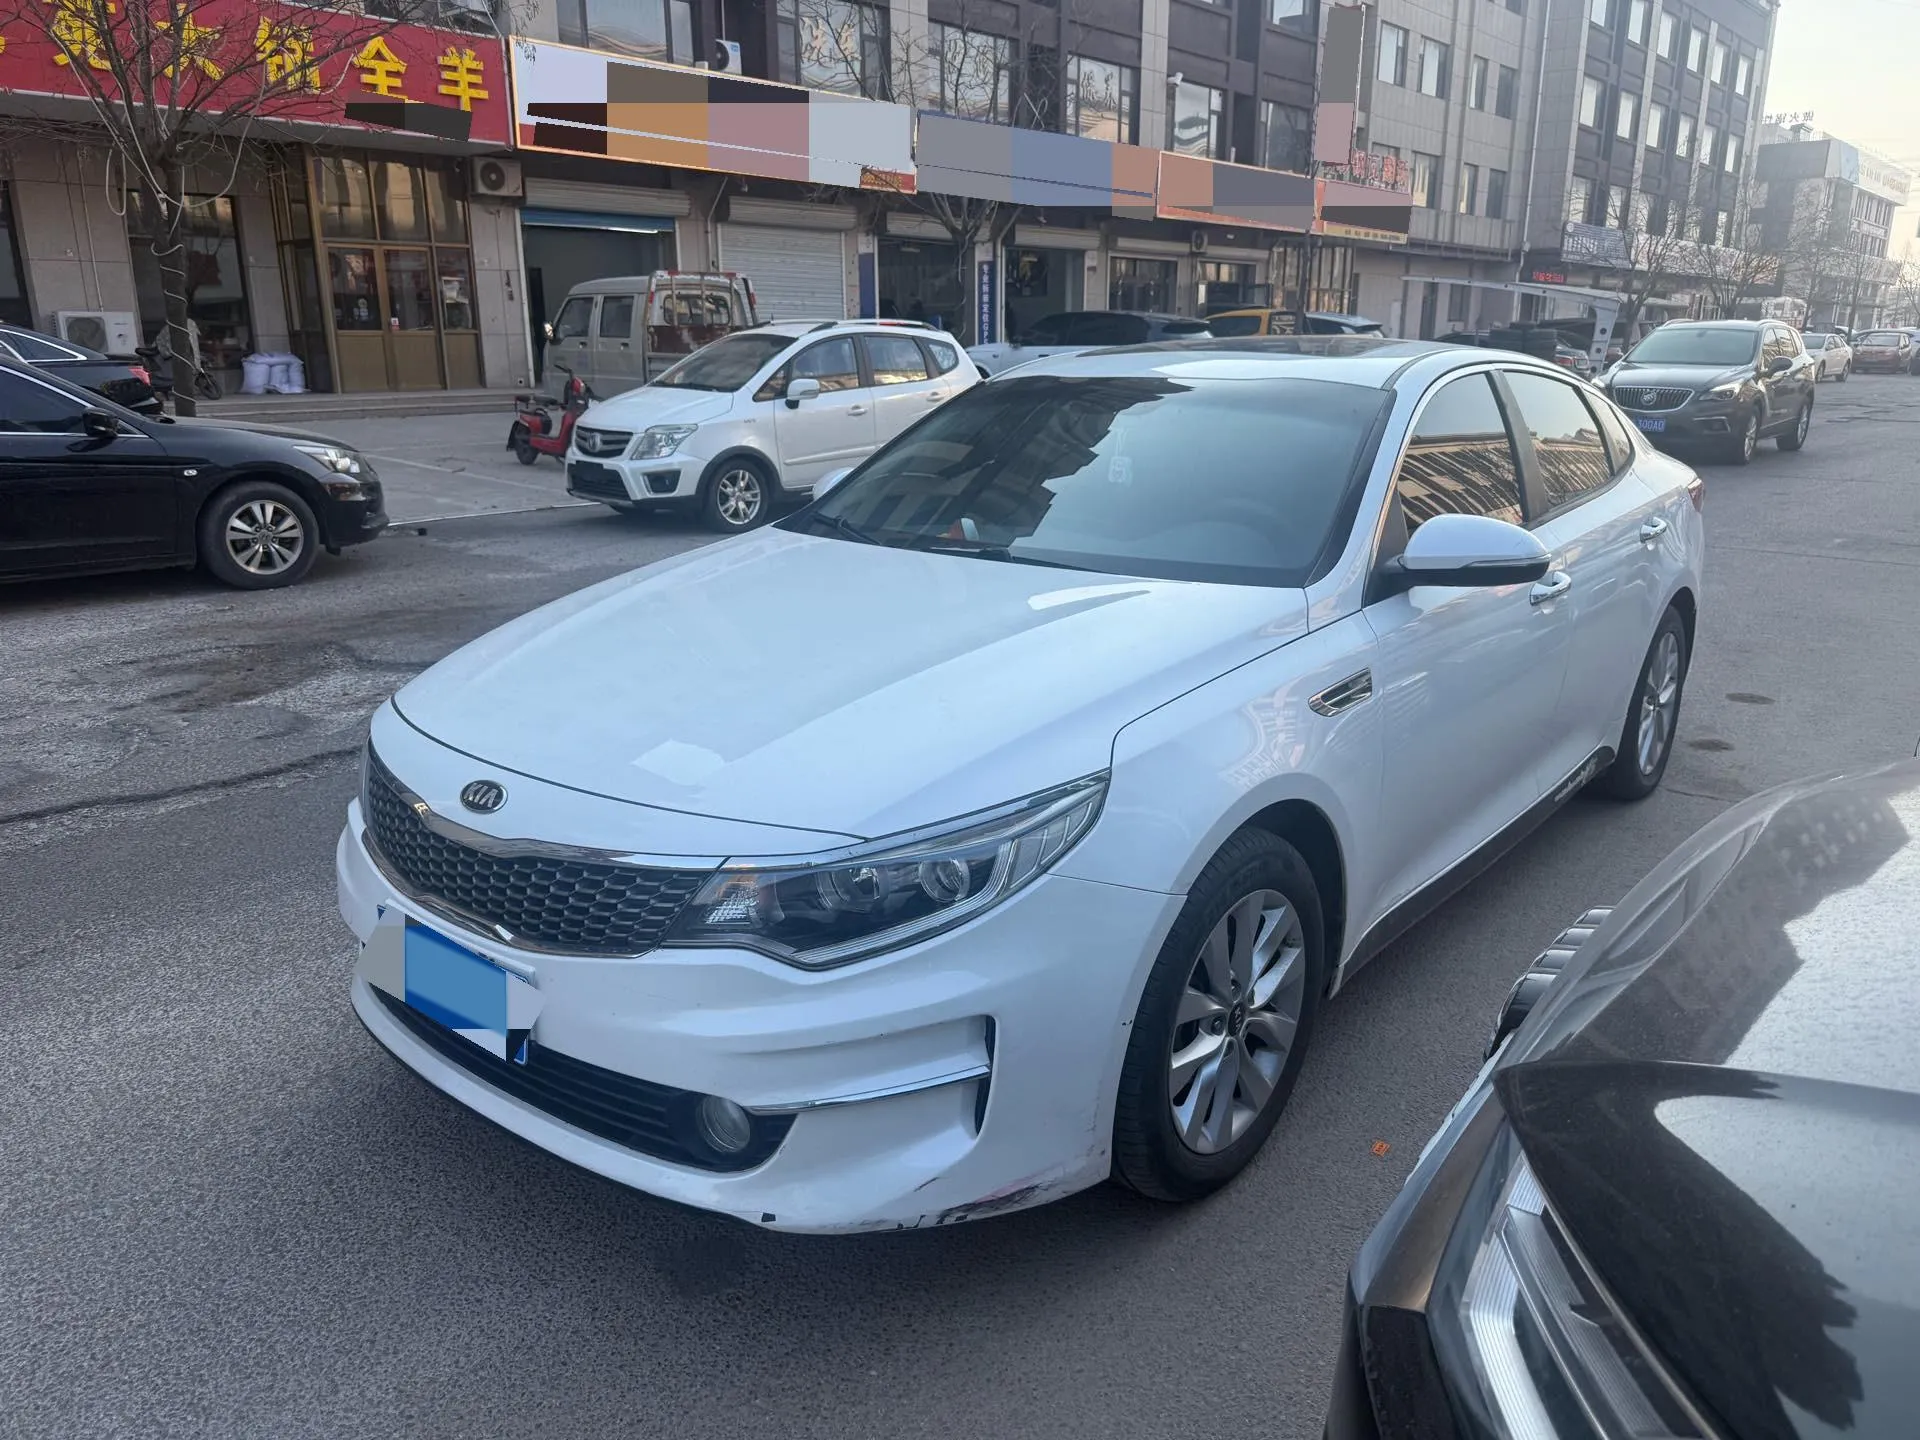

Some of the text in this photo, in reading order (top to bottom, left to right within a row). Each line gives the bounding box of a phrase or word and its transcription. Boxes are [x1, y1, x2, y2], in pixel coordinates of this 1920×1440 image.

[0, 0, 489, 112] 大锅全羊
[463, 782, 499, 808] KIA
